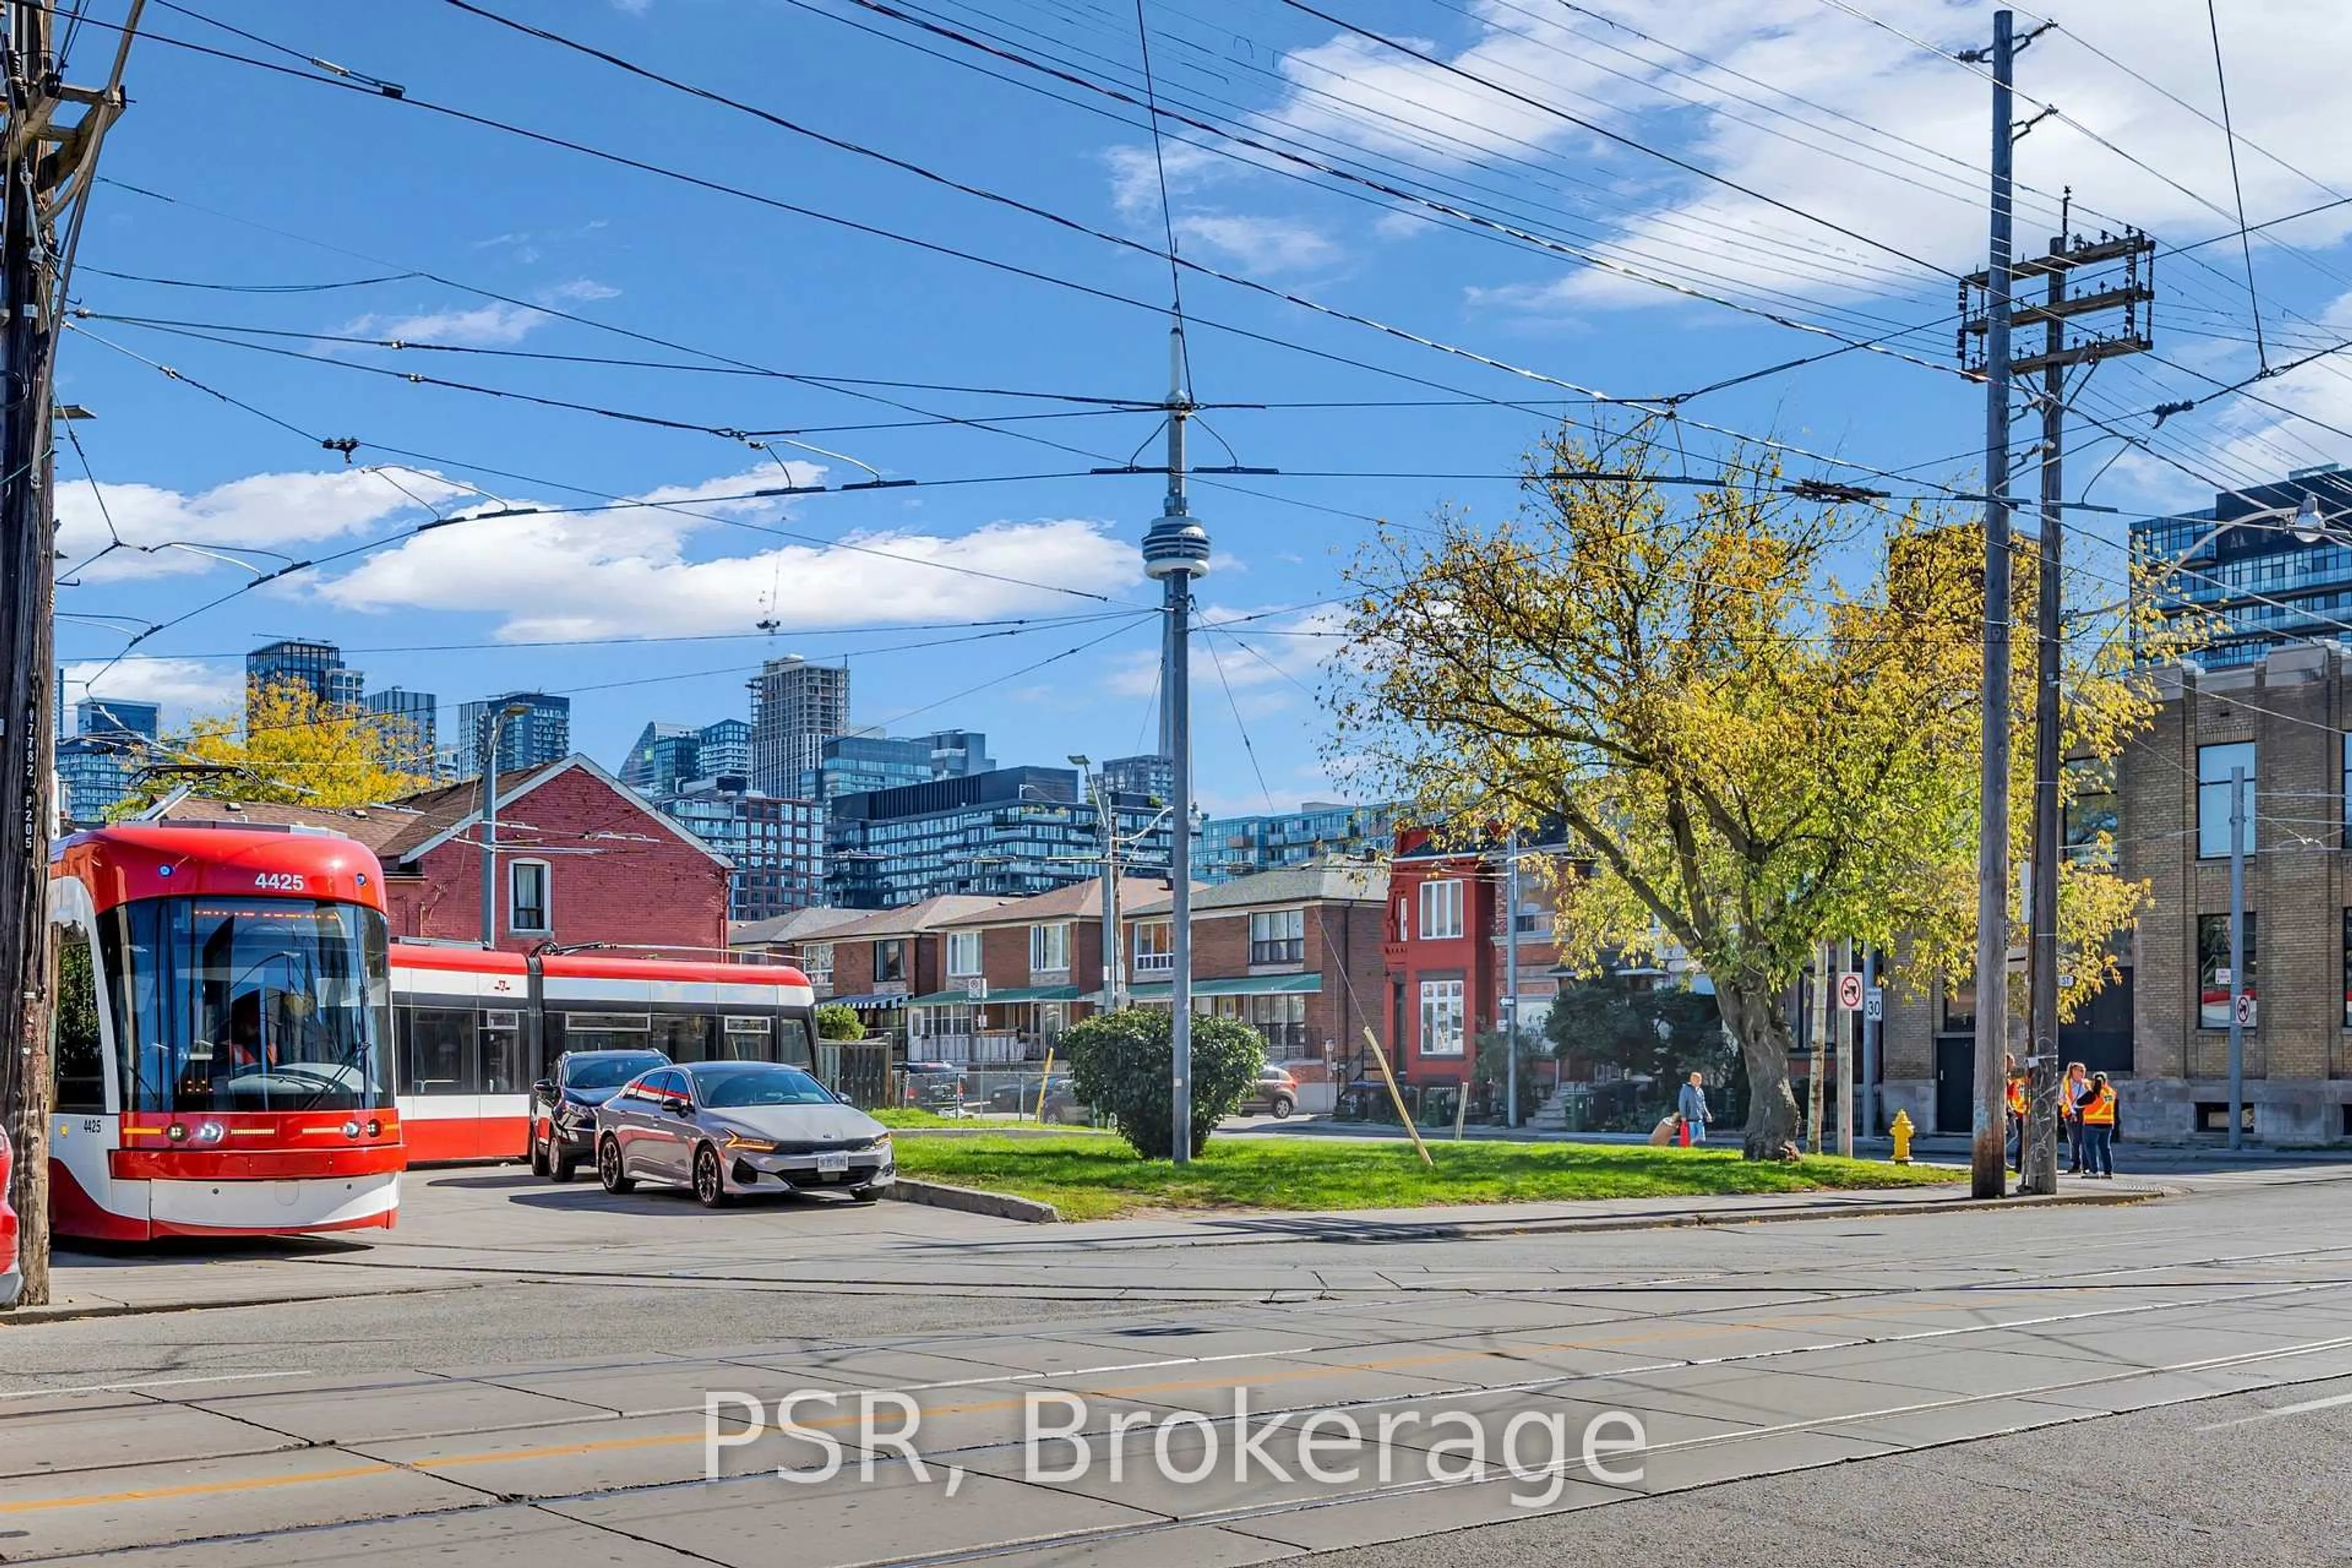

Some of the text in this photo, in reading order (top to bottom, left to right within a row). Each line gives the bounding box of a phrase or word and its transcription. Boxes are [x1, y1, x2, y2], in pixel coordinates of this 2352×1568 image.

[255, 873, 304, 891] 4425
[1868, 1000, 1880, 1016] 30
[83, 1119, 101, 1133] 4425
